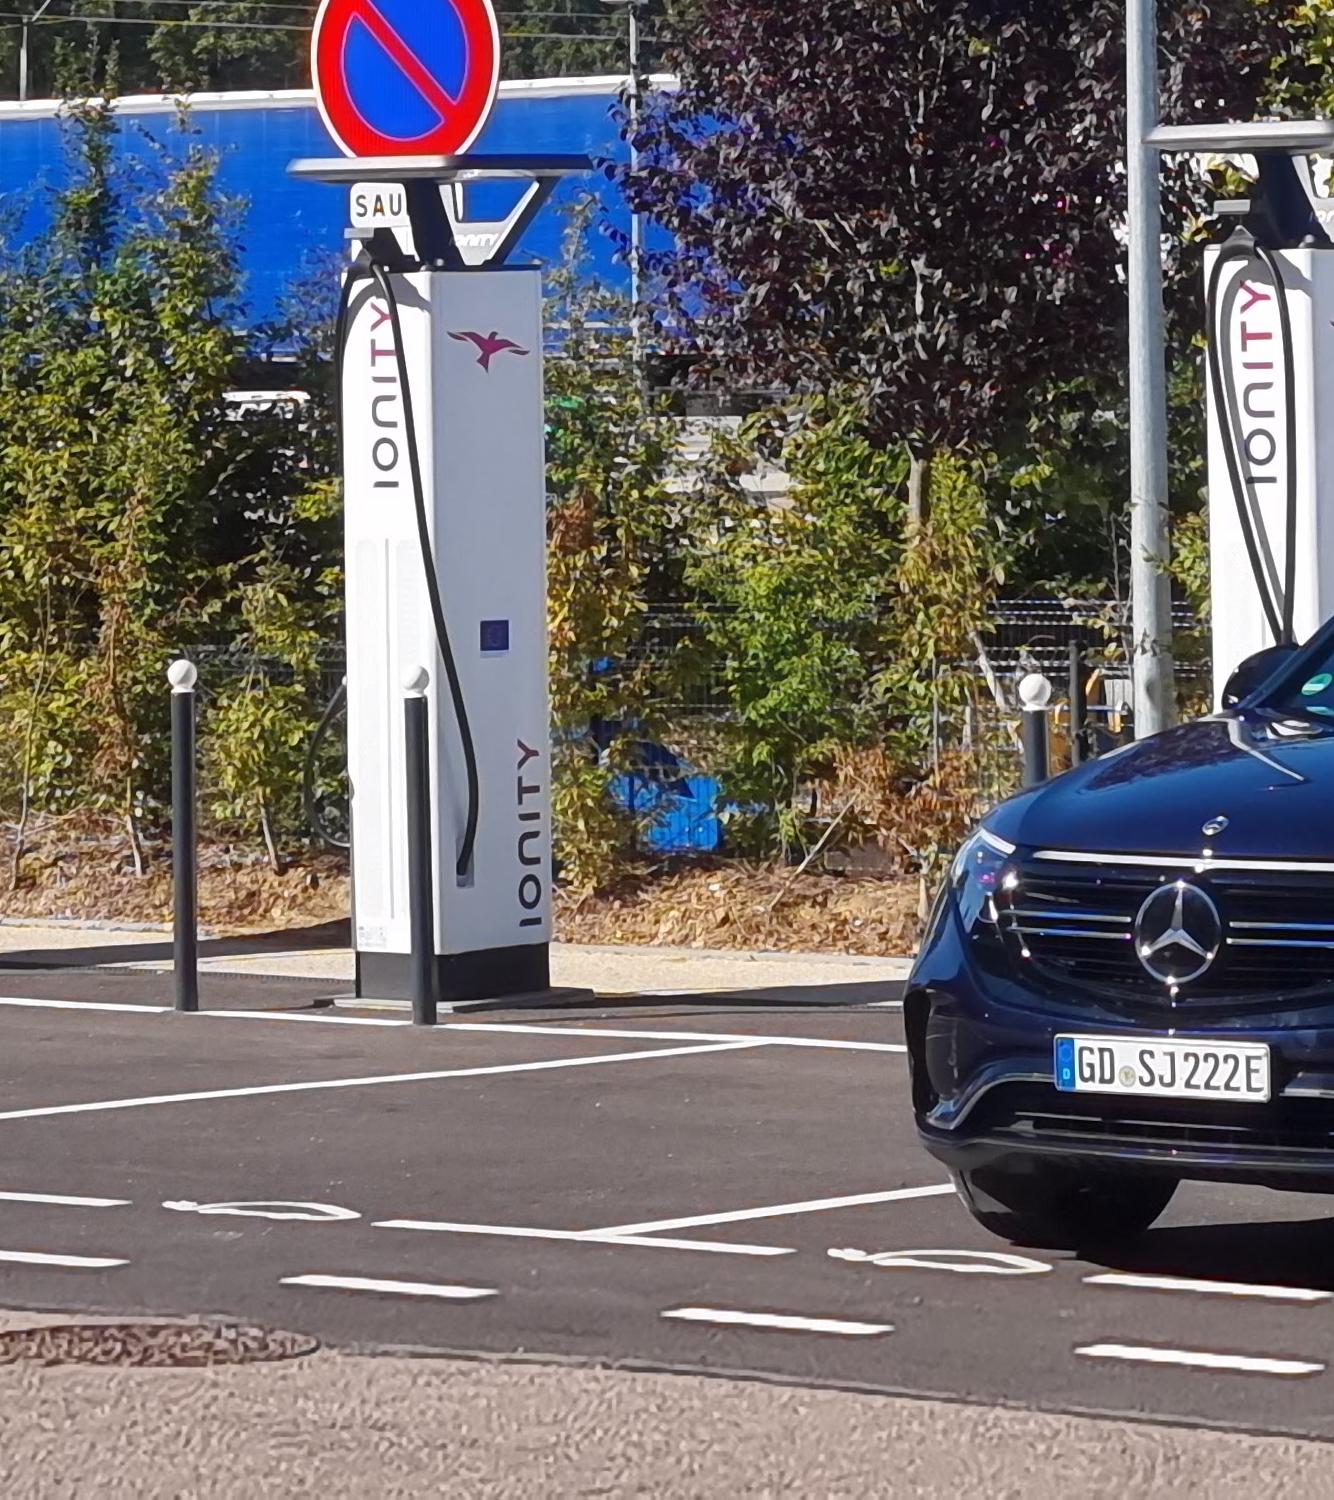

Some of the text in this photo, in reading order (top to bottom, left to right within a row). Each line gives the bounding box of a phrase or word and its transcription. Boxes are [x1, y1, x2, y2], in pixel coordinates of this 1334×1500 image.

[355, 193, 402, 218] SAU
[370, 301, 400, 488] IONITY
[1239, 279, 1277, 485] IONITY
[517, 738, 542, 927] IONITY
